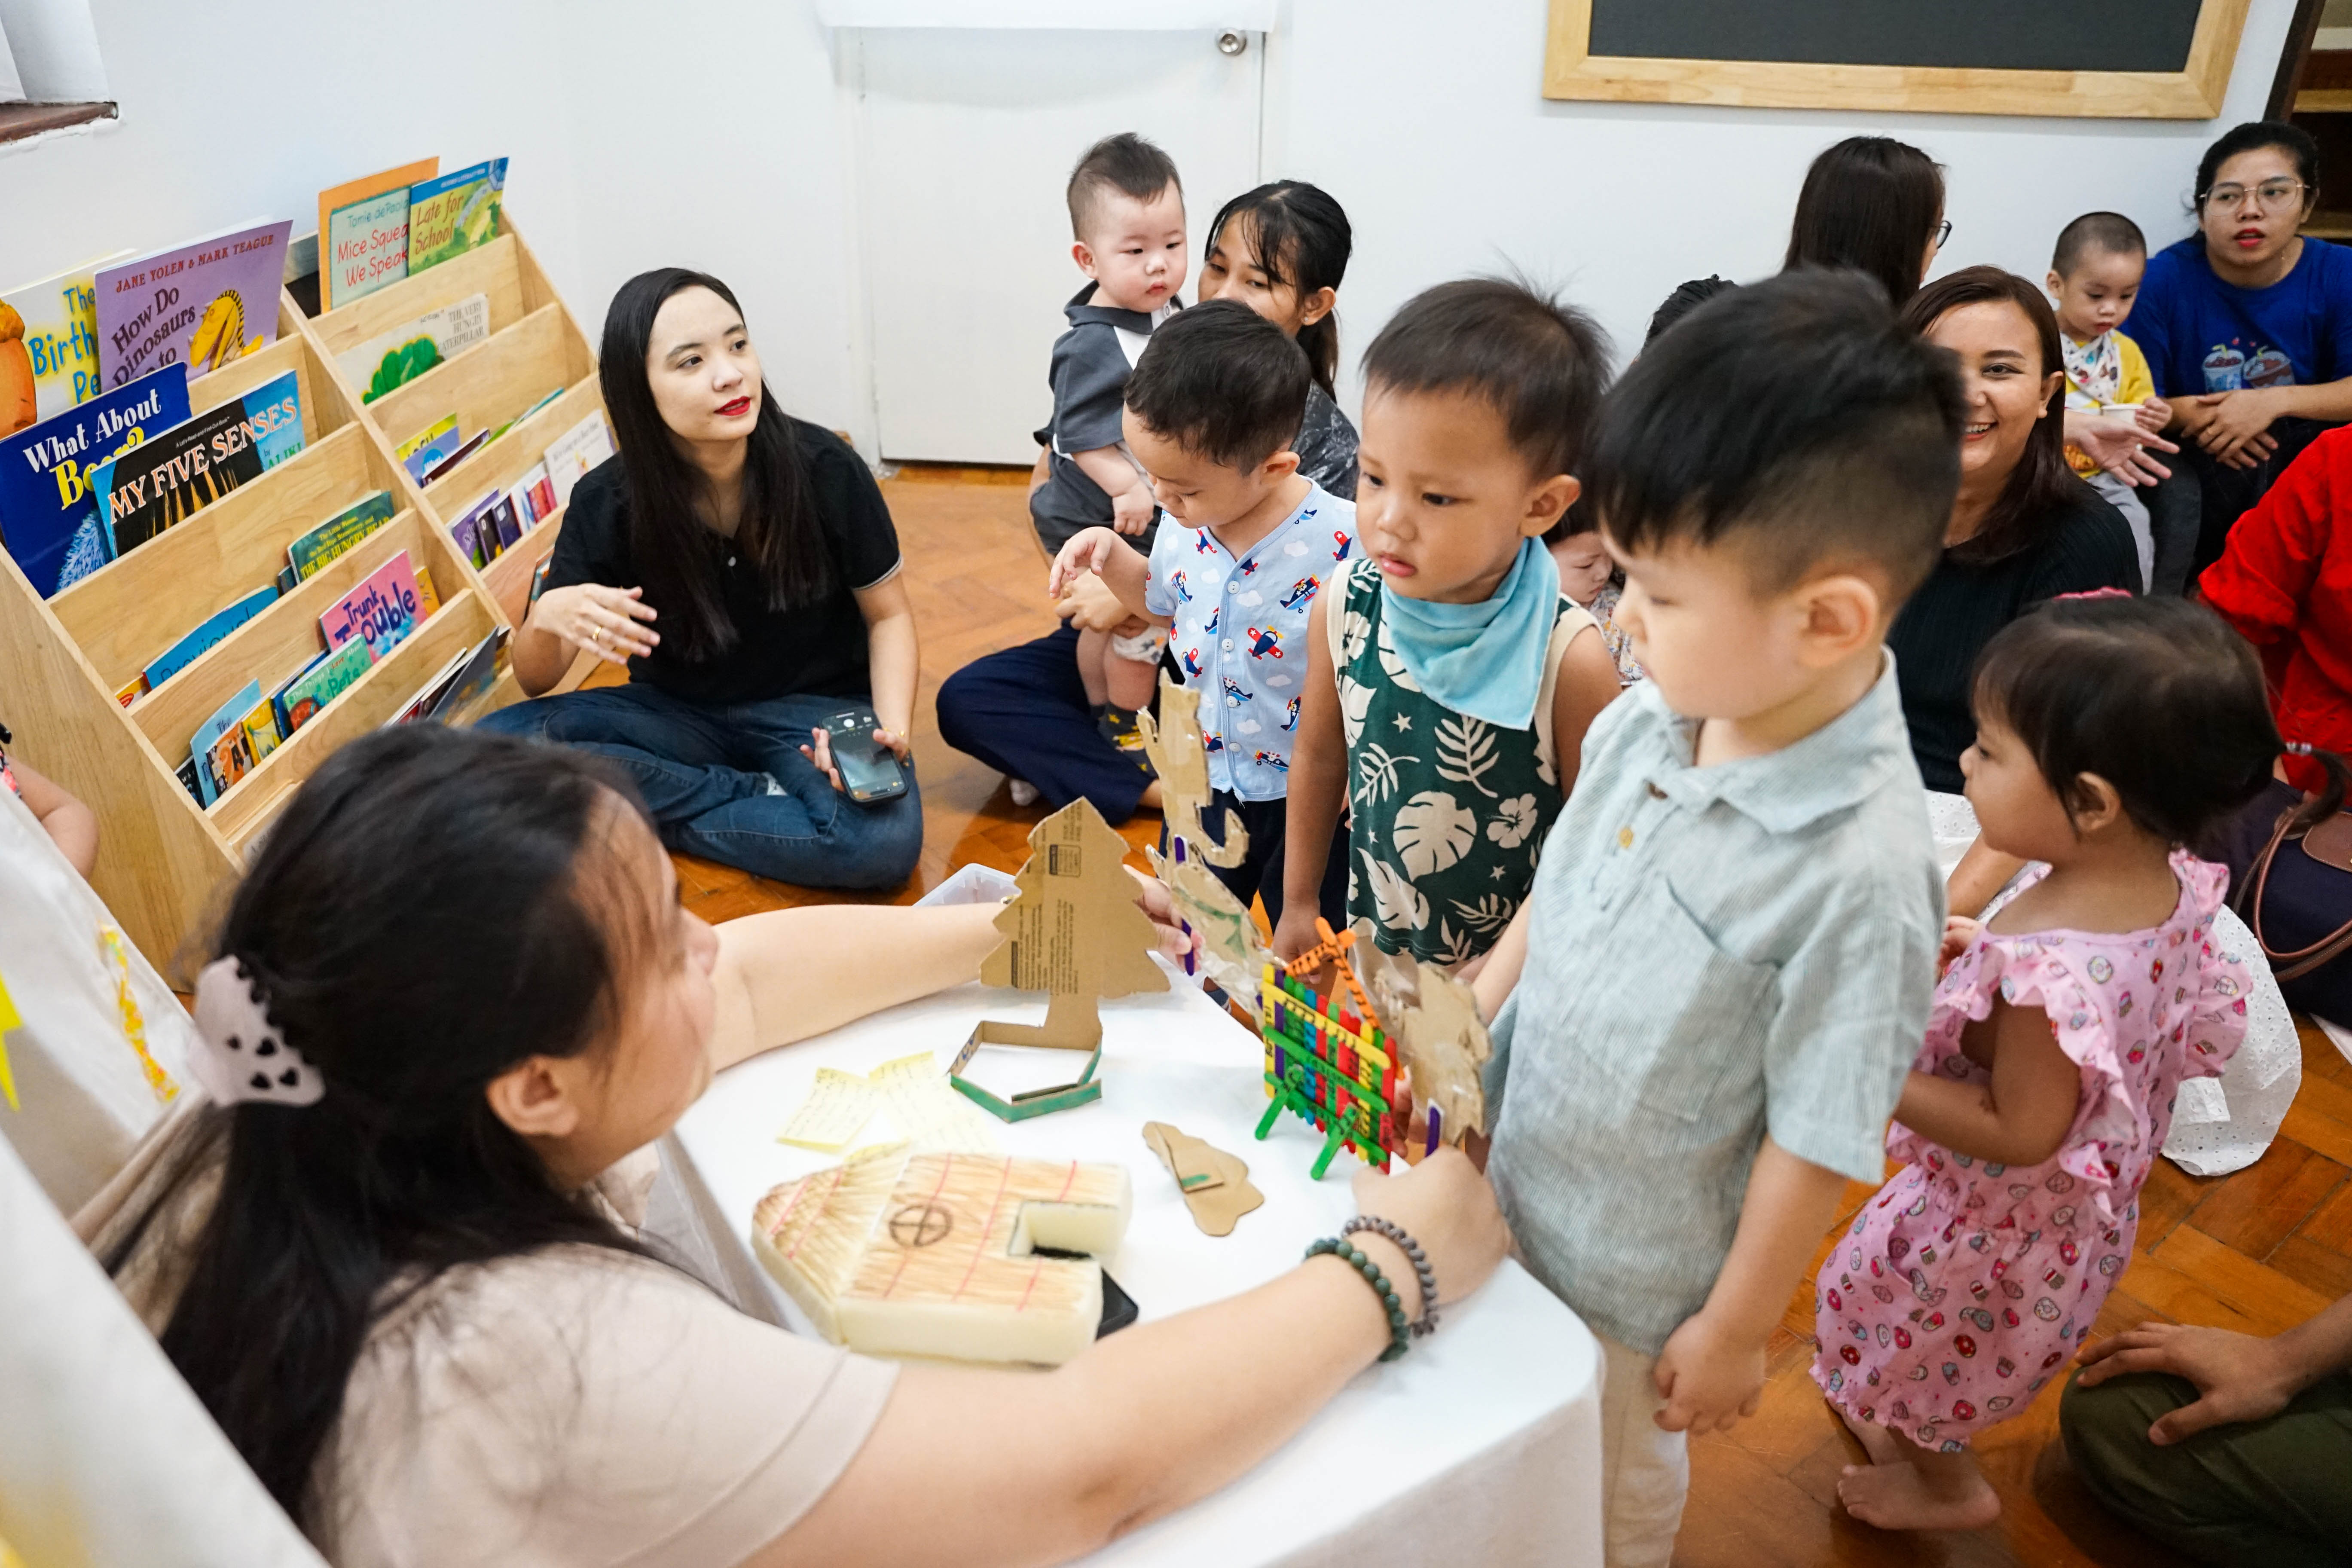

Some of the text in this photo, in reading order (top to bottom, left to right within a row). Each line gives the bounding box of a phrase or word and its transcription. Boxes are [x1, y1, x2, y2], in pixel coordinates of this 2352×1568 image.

[417, 192, 464, 227] Late for
[337, 240, 368, 265] Mice
[415, 217, 454, 255] School
[116, 235, 274, 293] JANE YOLEN & MARK TEAGUE
[346, 244, 409, 287] We Speak
[63, 285, 95, 313] The
[111, 287, 179, 356] How Do
[112, 306, 195, 386] Dinosaurs
[159, 348, 176, 367] to
[22, 388, 162, 473] What About
[107, 397, 297, 525] MY FIVE SENSES
[264, 449, 270, 457] by
[300, 560, 316, 579] THE
[316, 551, 332, 569] BIG
[331, 529, 365, 559] HUNGRY
[343, 584, 379, 626] Trunk
[331, 657, 345, 669] Love
